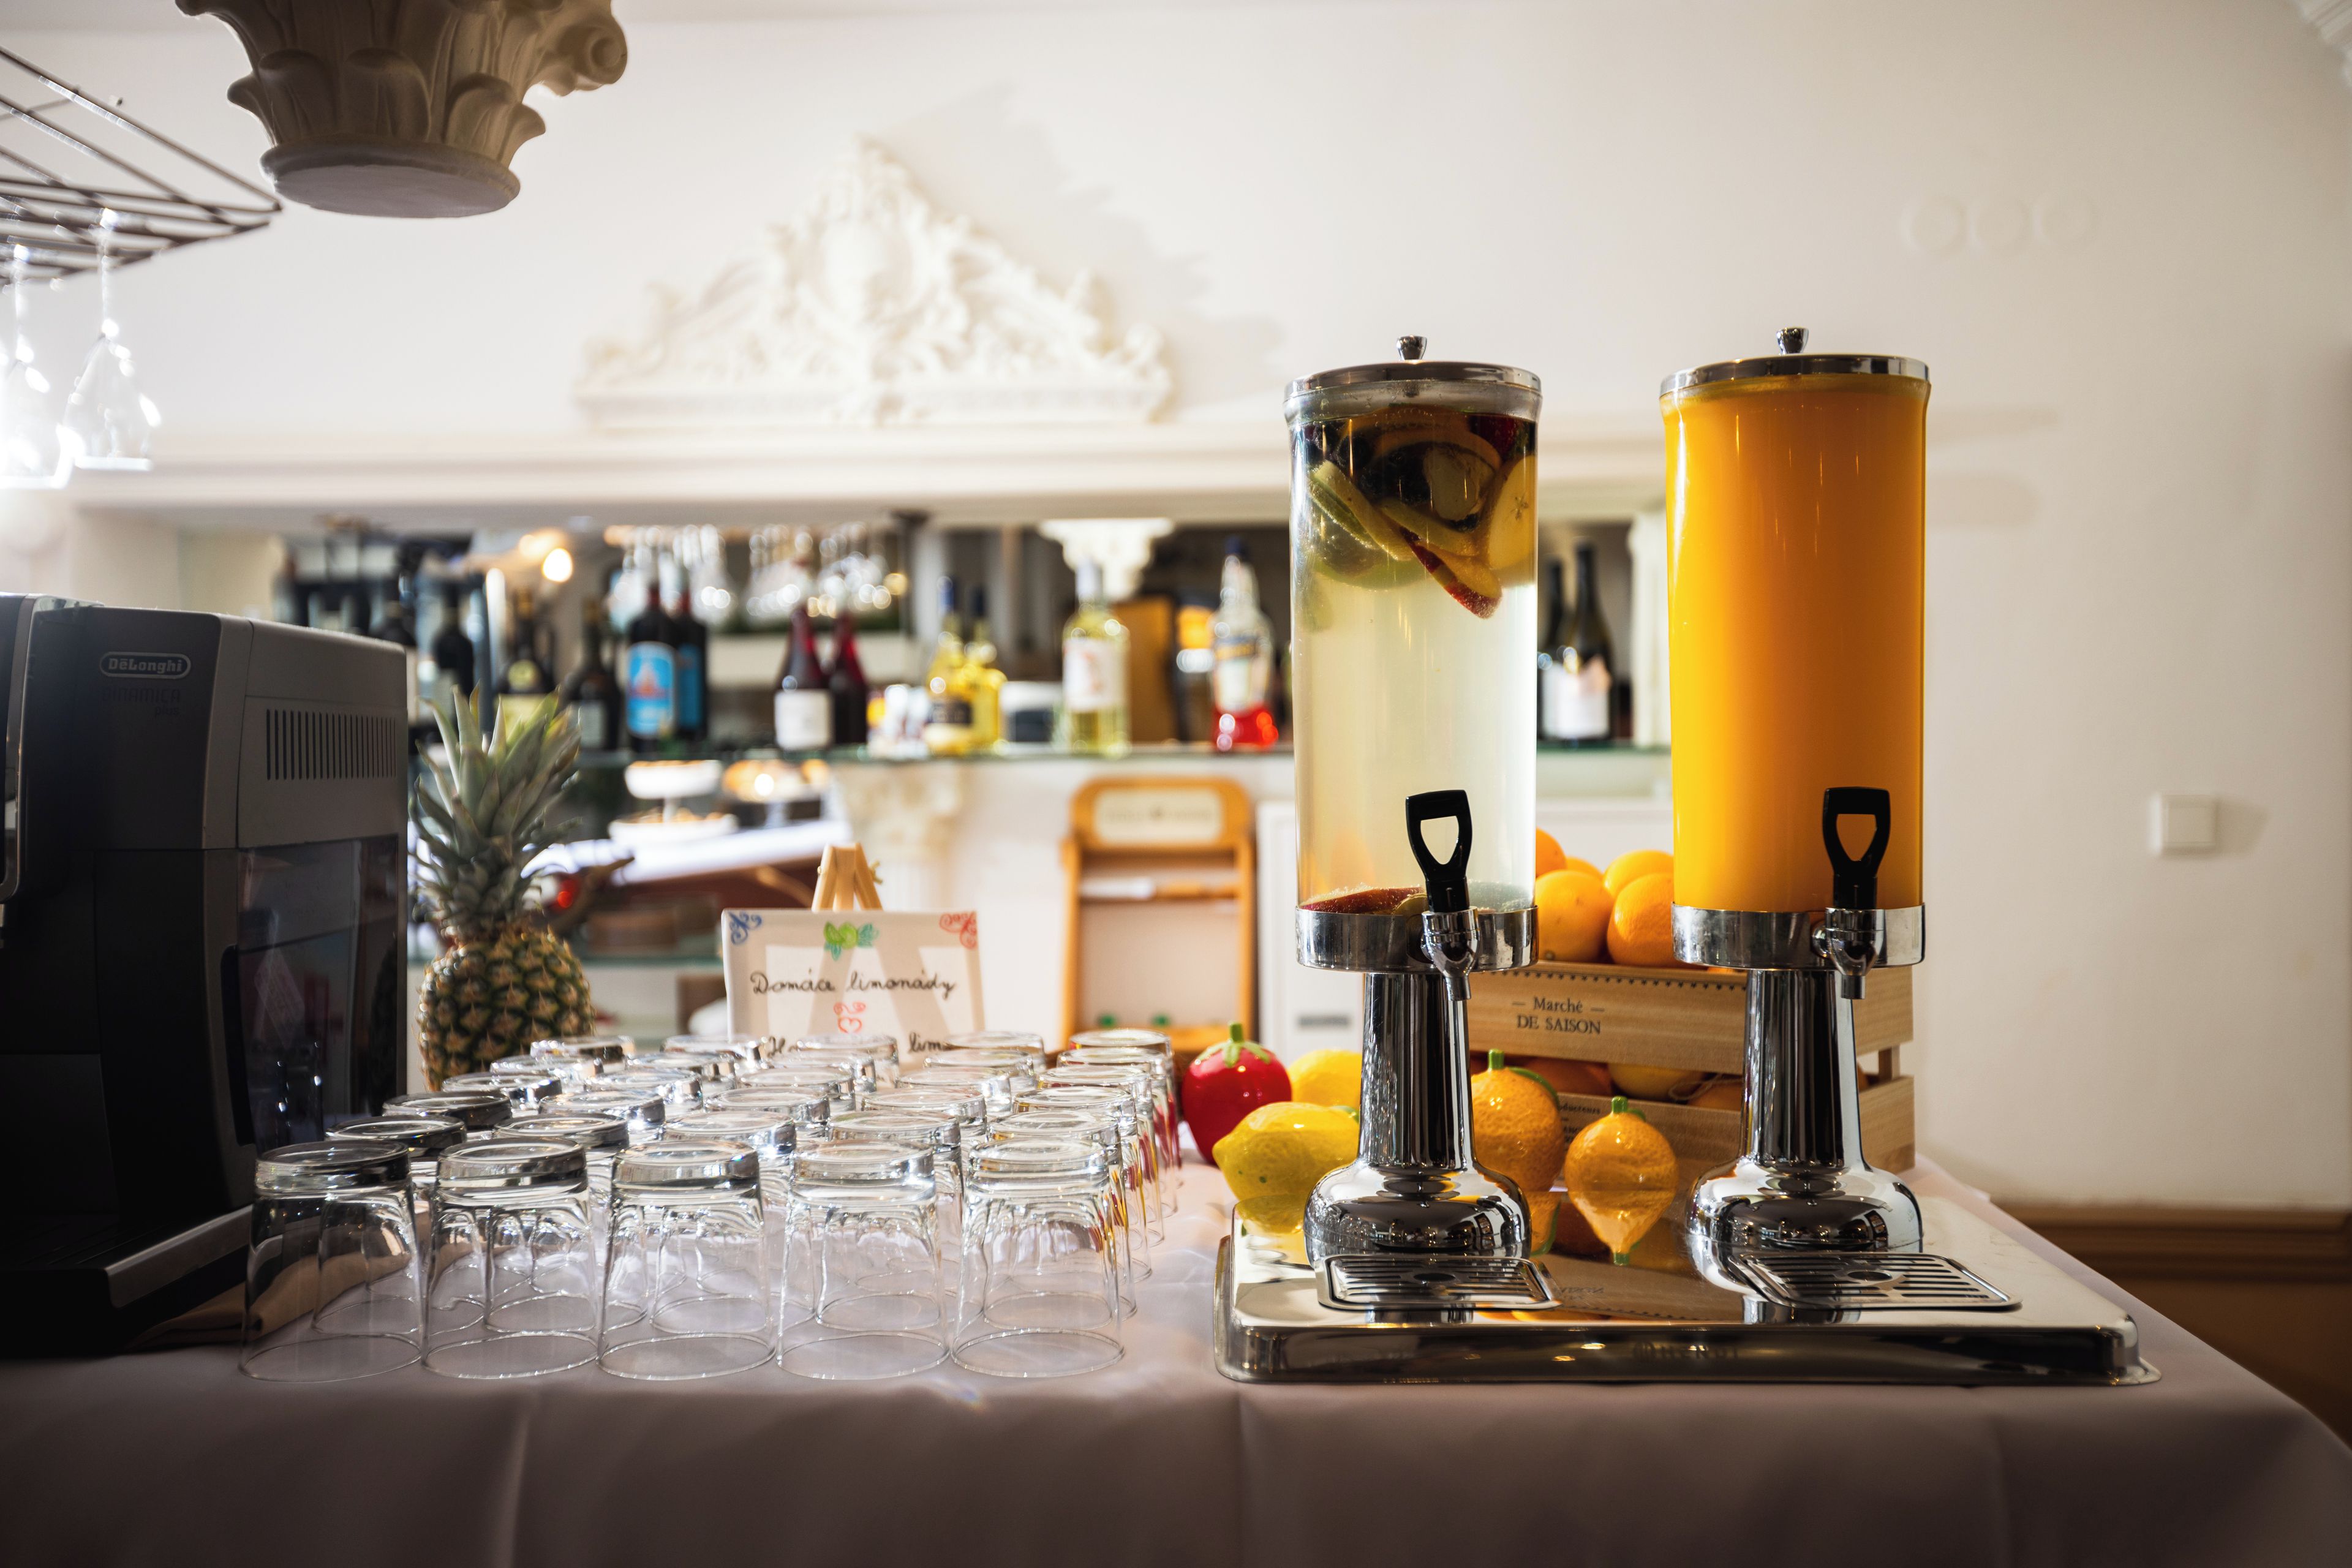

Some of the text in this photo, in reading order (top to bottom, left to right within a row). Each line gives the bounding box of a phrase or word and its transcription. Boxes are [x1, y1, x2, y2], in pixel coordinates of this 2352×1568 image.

[1533, 997, 1583, 1014] Marché
[1517, 1014, 1602, 1035] DE SAISON
[907, 1031, 944, 1054] lim
